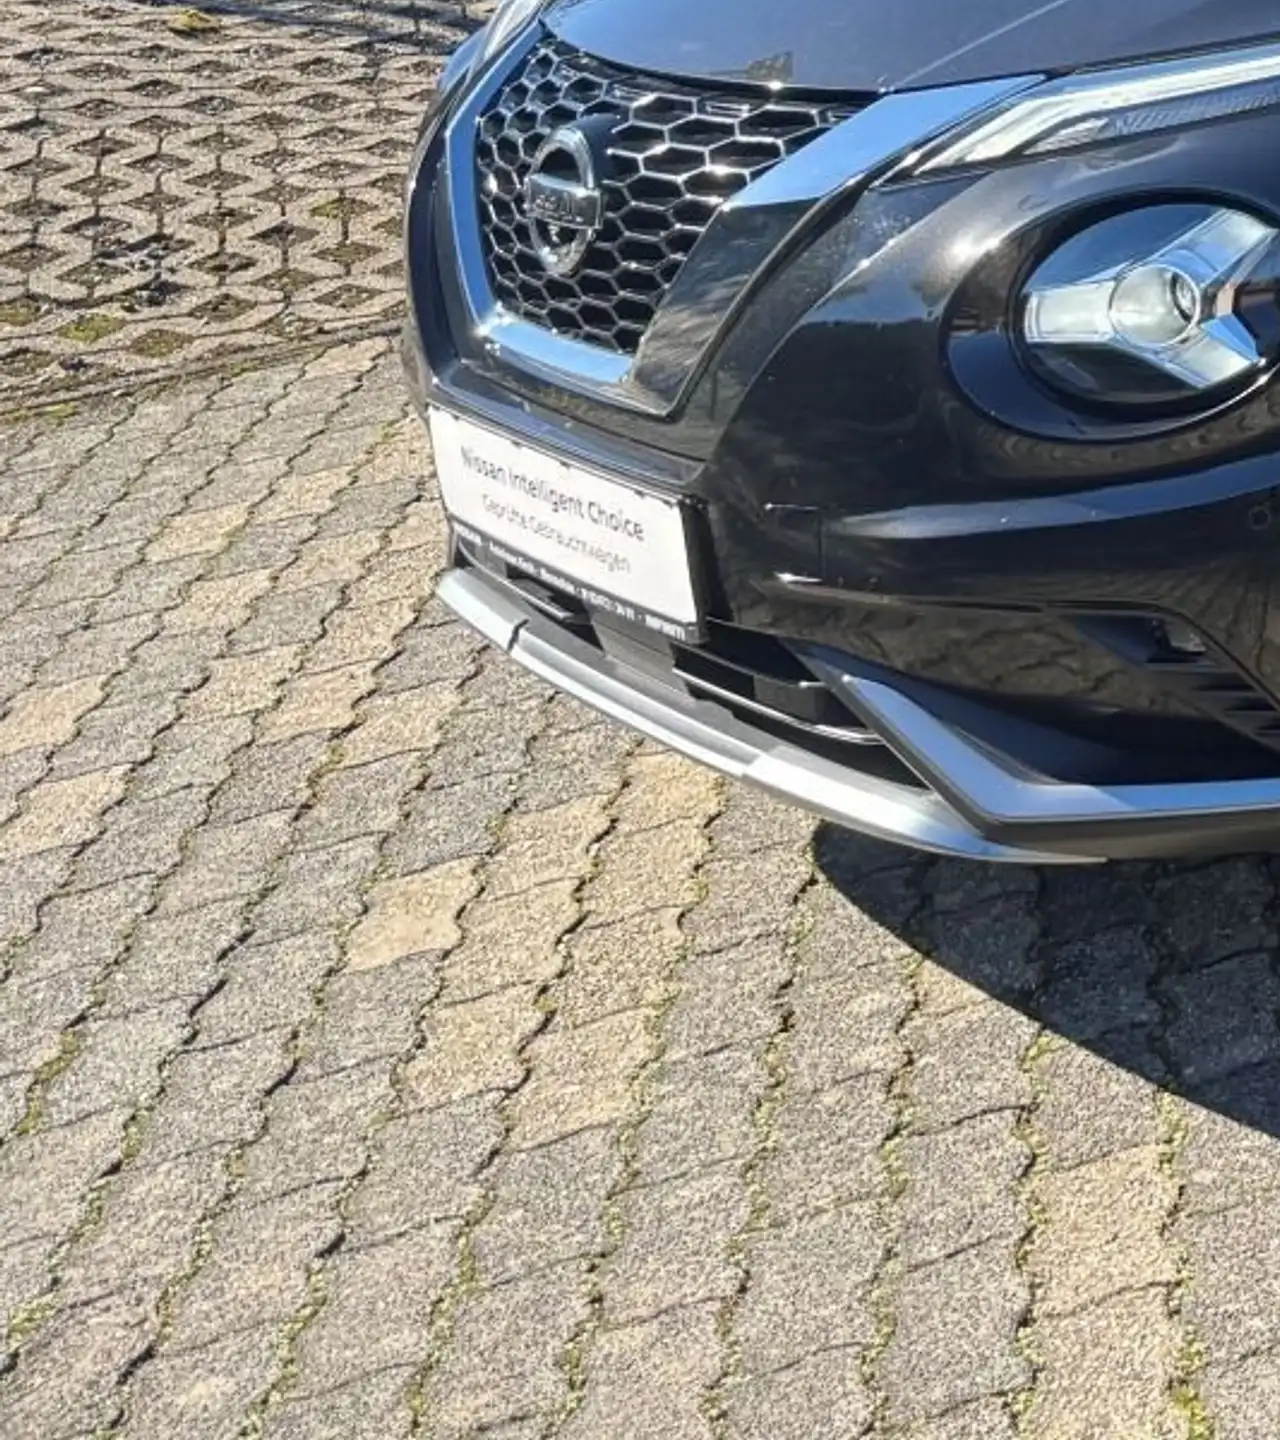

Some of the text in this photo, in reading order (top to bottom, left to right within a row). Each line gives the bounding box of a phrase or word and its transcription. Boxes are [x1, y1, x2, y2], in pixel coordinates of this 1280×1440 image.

[460, 445, 645, 542] Nissan Intelligent Choice
